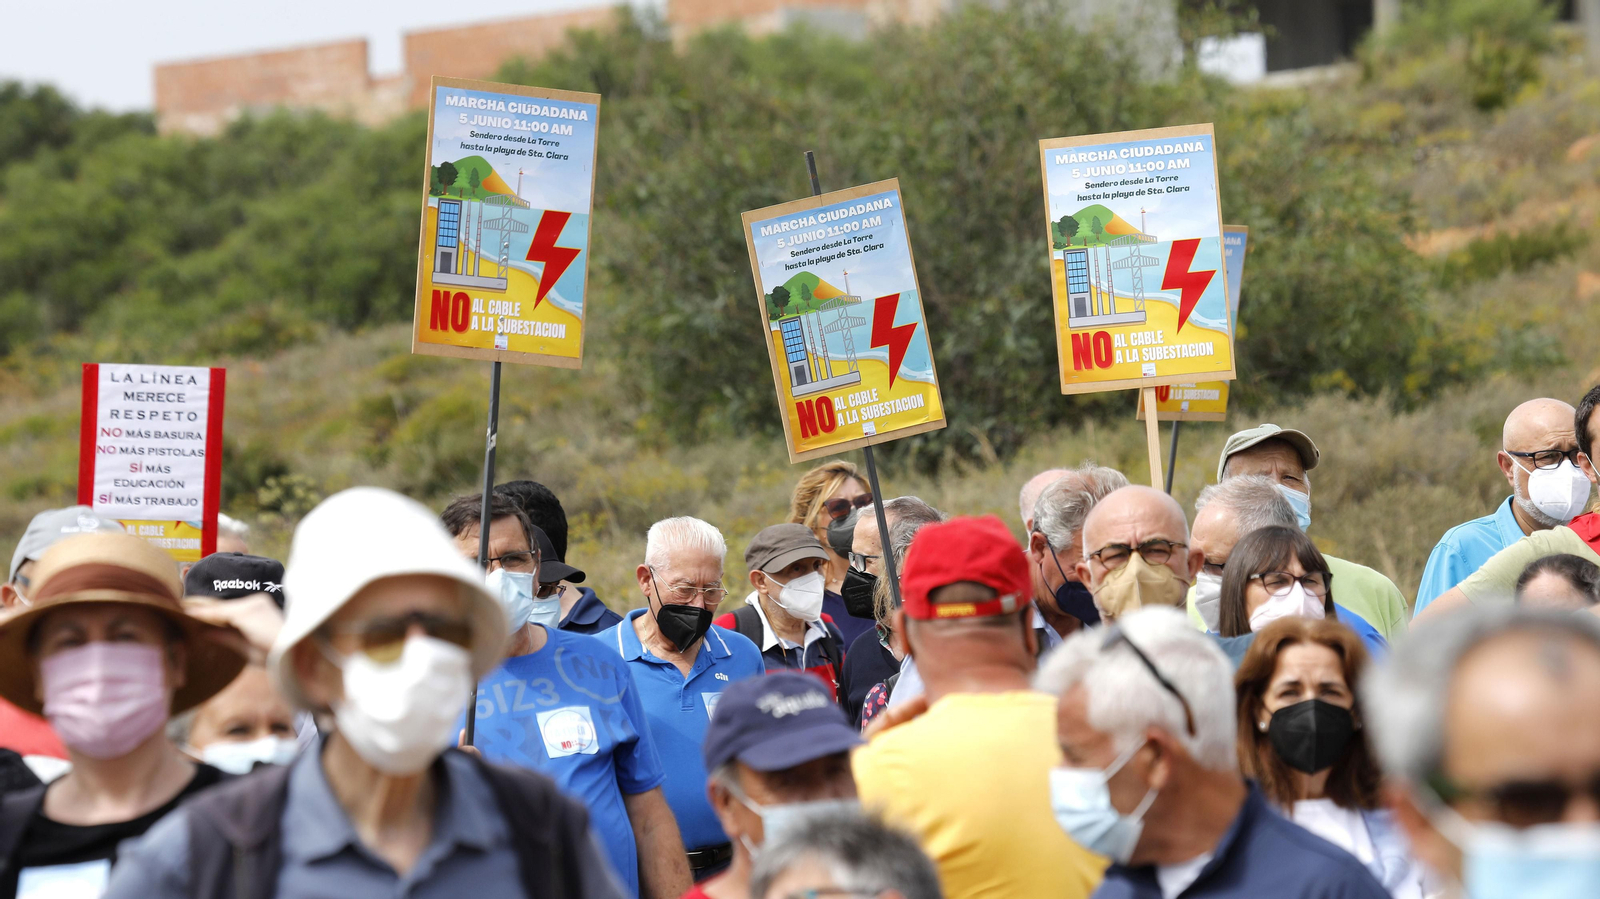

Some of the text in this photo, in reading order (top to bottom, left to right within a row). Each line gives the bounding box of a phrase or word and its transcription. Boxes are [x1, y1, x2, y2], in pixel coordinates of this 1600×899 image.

[446, 95, 588, 121] MARCHA CIUDADANA
[459, 113, 573, 136] 5 JUNIO 11:00 AM
[470, 130, 502, 141] Sendero
[503, 133, 526, 143] desde
[538, 138, 560, 147] Torre
[460, 142, 569, 161] hasta la playa de Sta. Clara
[1055, 141, 1204, 165] MARCHA CIUDADANA
[1072, 158, 1190, 179] 5 JUNIO 11:00 AM
[1085, 174, 1179, 190] Sendero desde La Torre
[1077, 192, 1101, 202] hasta
[1111, 190, 1134, 200] playa
[1135, 189, 1146, 197] de
[1147, 187, 1164, 196] Sta.
[1166, 184, 1190, 194] Clara
[760, 198, 893, 236] MARCHA CIUDADANA
[777, 215, 882, 248] 5 JUNIO 11:00 AM
[790, 246, 820, 257] Sendero
[822, 241, 842, 251] desde
[853, 233, 873, 243] Torre
[785, 260, 806, 271] hasta
[808, 258, 814, 266] la
[815, 254, 836, 266] playa
[846, 248, 862, 257] Sta.
[863, 243, 884, 253] Clara
[430, 290, 470, 333] NO
[472, 298, 521, 317] AL CABLE
[471, 316, 566, 338] A LA SUBESTACION
[1114, 330, 1164, 348] AL CABLE
[1071, 330, 1113, 370] NO
[1116, 342, 1214, 364] A LA SUBESTACION
[111, 372, 197, 385] LA LÍNEA
[124, 391, 185, 403] MERECE
[834, 388, 879, 411] AL CABLE
[110, 409, 198, 421] RESPETO
[796, 396, 836, 438] NO
[838, 394, 924, 427] A LA SUBESTACION
[100, 427, 202, 440] NO MÁS BASURA
[97, 445, 204, 457] NO MÁS PISTOLAS
[129, 461, 170, 473] SÍ MÁS
[114, 478, 184, 488] EDUCACIÓN
[99, 492, 198, 506] SÍ MÁS TRABAJO
[127, 525, 164, 536] AL CABLE
[213, 579, 260, 591] Reebok
[715, 673, 728, 681] Gill
[561, 741, 572, 750] NO
